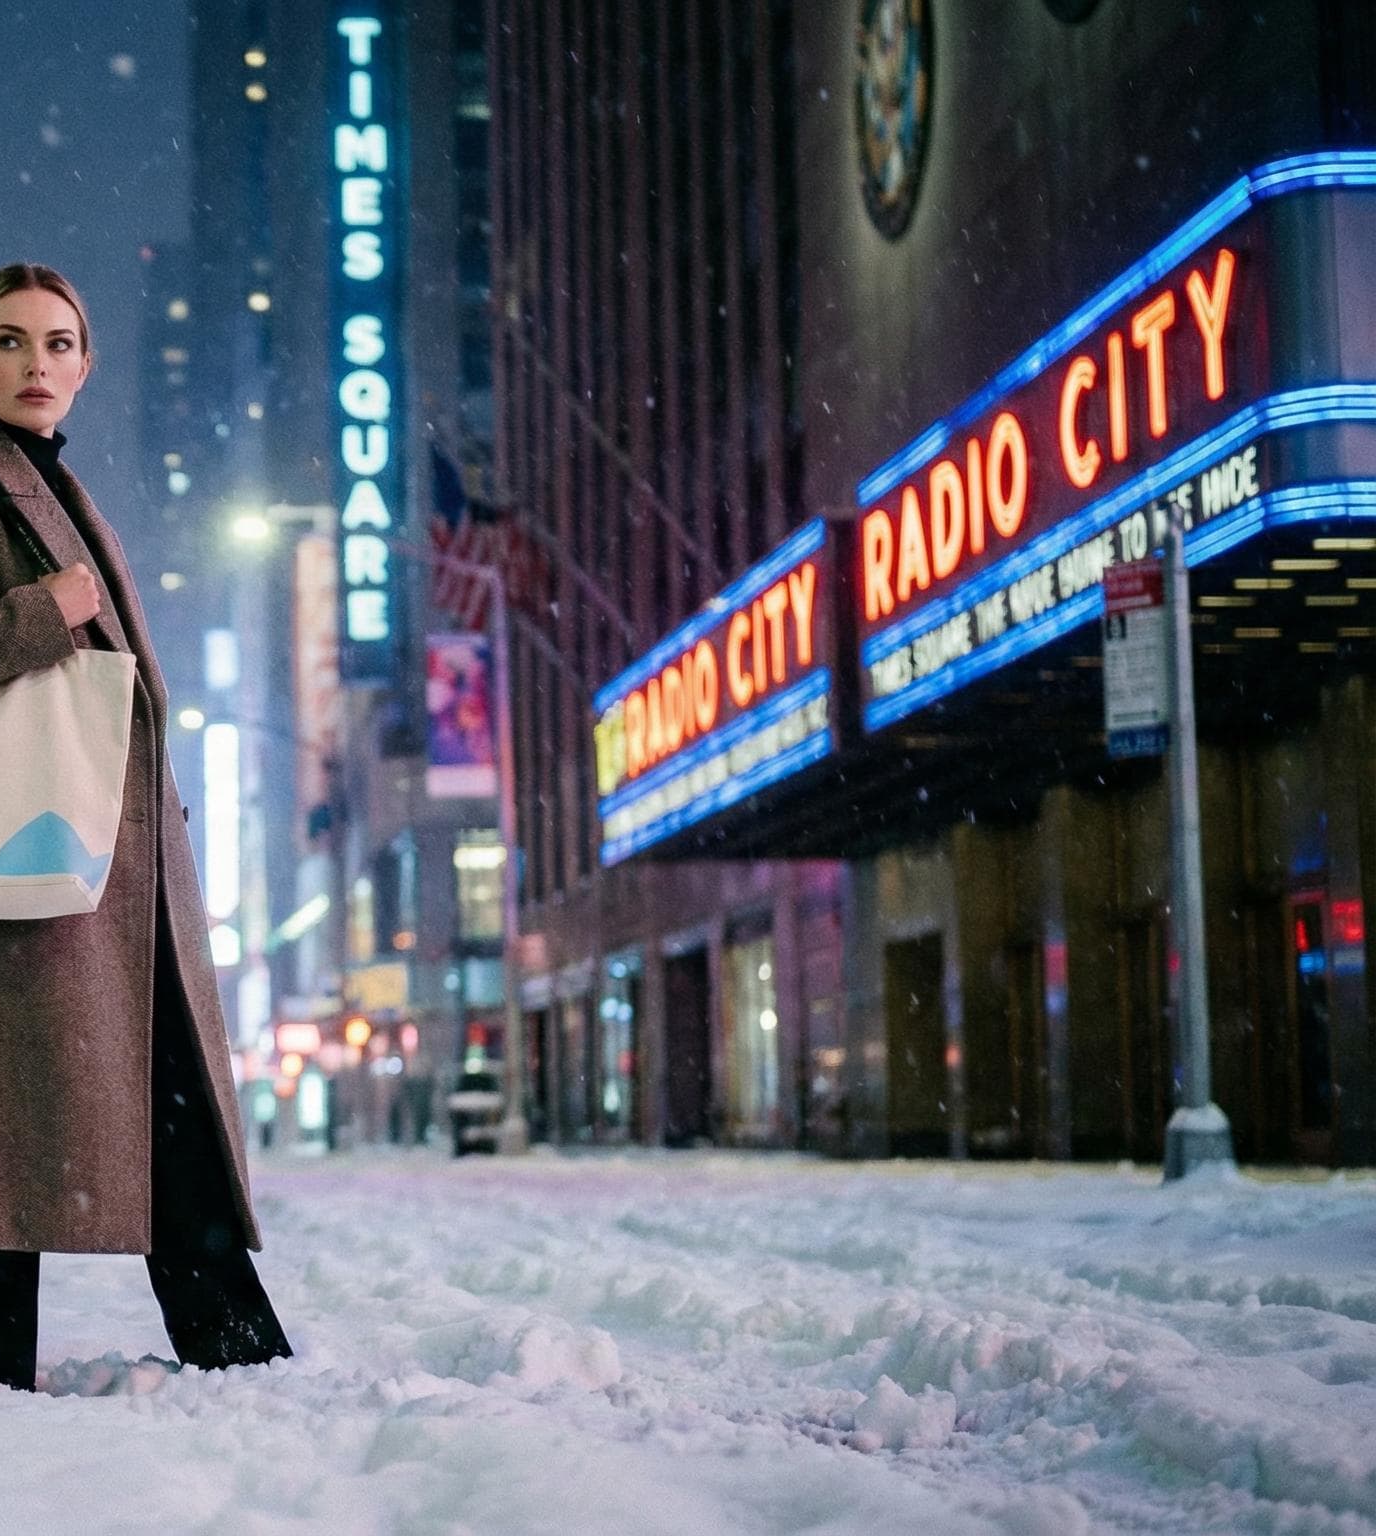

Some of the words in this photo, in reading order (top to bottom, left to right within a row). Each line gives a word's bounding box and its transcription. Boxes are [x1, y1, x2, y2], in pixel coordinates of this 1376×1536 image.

[335, 17, 387, 281] TIMES
[338, 313, 392, 642] SQUARE
[861, 410, 1029, 622] RADIO
[1058, 246, 1237, 490] CITY
[624, 638, 719, 779] RADIO
[727, 562, 817, 707] CITY
